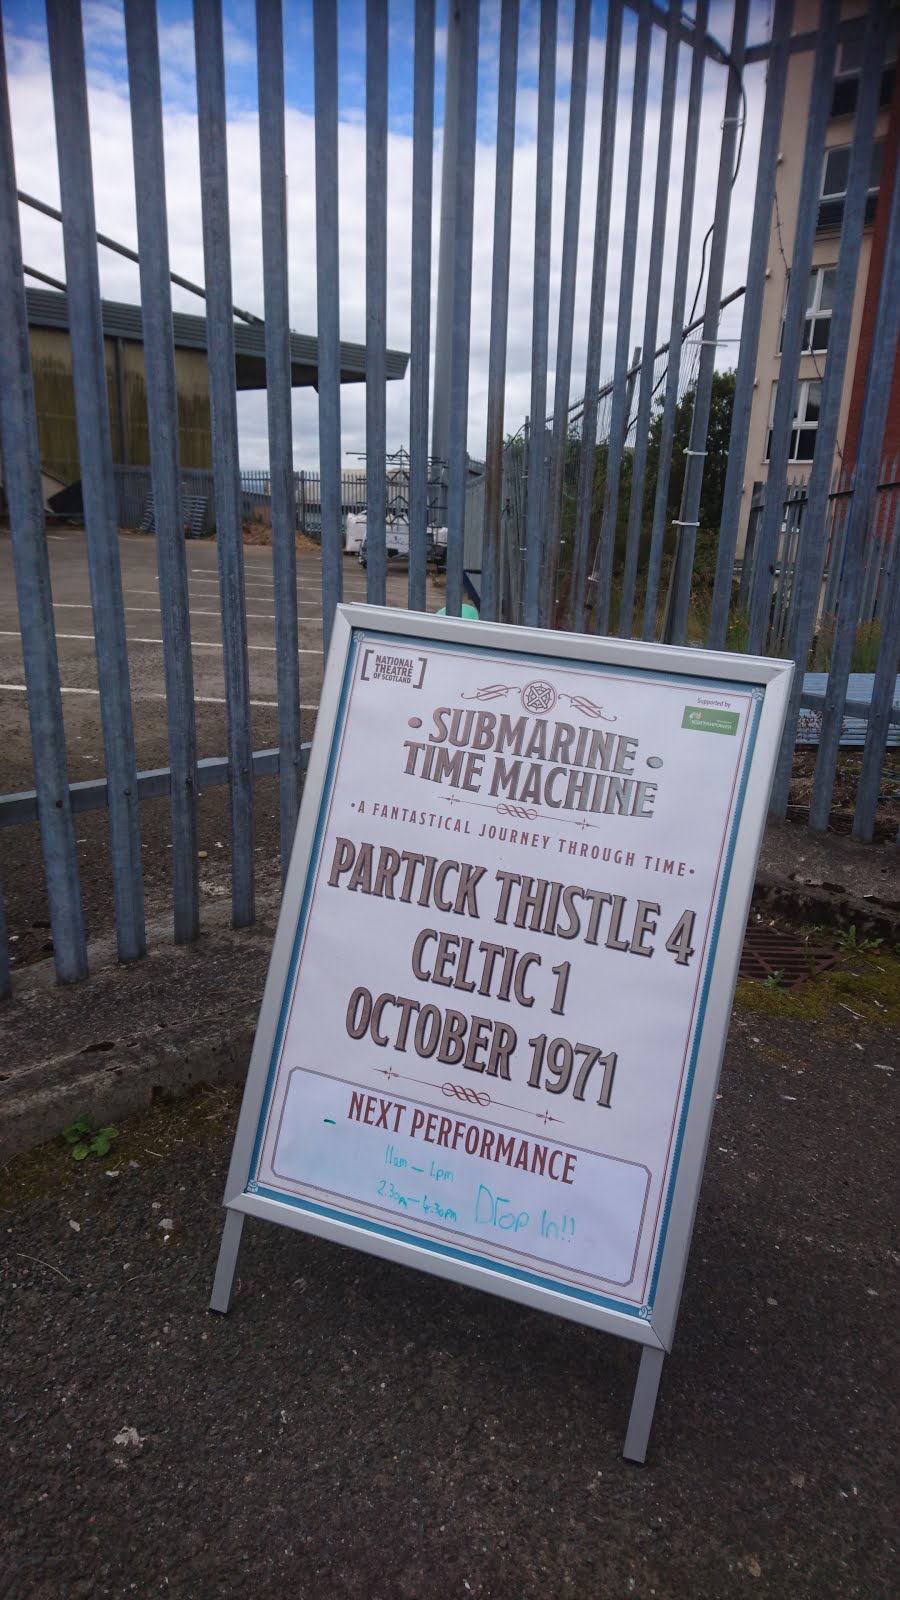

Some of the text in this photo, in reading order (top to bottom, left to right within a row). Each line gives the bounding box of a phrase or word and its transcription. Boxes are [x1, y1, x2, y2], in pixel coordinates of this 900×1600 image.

[373, 672, 412, 684] OF SCOTLAND
[375, 663, 413, 678] THEATRE
[376, 654, 414, 669] NATIONAL
[697, 698, 732, 709] Supported by
[428, 706, 639, 775] SUBMARINE
[403, 740, 658, 819] TIME MACHINE
[372, 802, 471, 834] FANTASTICAL
[478, 823, 551, 850] JOURNEY
[558, 838, 636, 867] THROUGH
[644, 855, 687, 877] TIME
[327, 836, 697, 966] PARTICK THISTLE 4
[411, 928, 572, 1016] CELTIC 1
[345, 986, 619, 1109] OCTOBER 1971
[347, 1091, 578, 1185] NEXT PERFORMANCE
[475, 1184, 530, 1232] Drop
